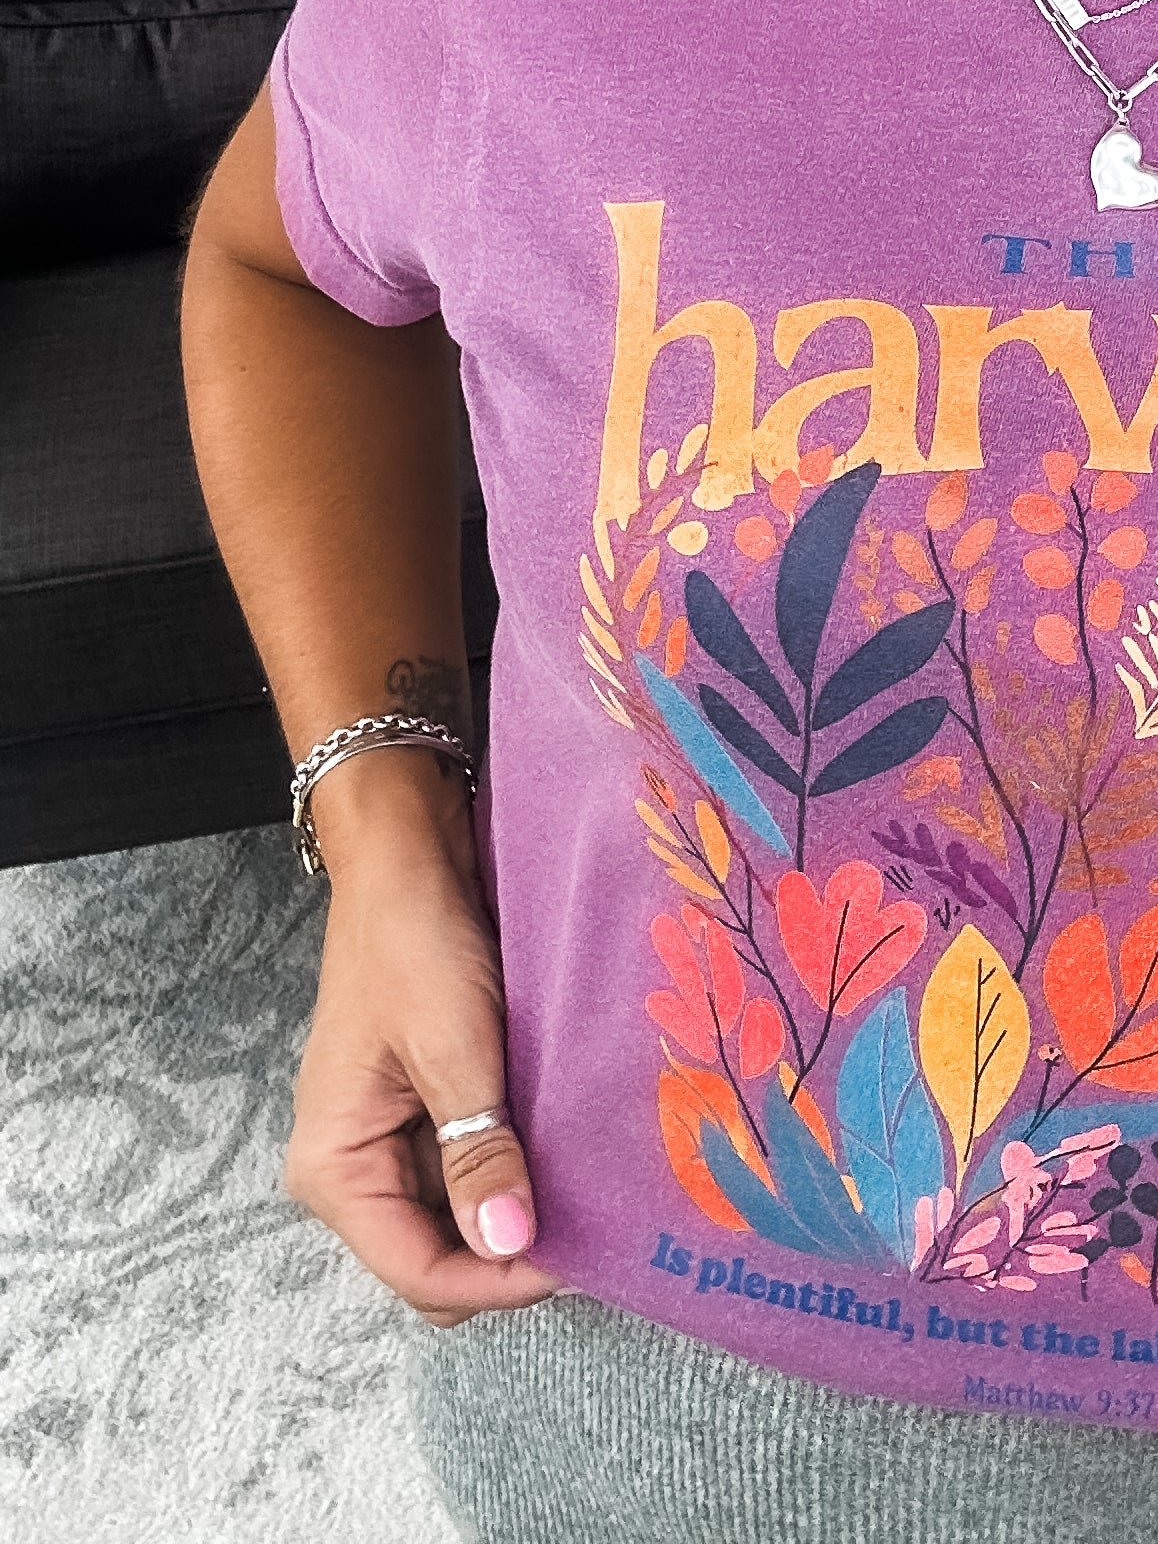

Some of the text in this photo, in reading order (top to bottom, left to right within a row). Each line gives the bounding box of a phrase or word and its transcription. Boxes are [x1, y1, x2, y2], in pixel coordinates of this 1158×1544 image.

[650, 1231, 693, 1278] Is
[697, 1256, 915, 1343] plentiful,
[926, 1305, 1009, 1348] but
[1020, 1321, 1100, 1358] the
[963, 1374, 1085, 1413] Matthew
